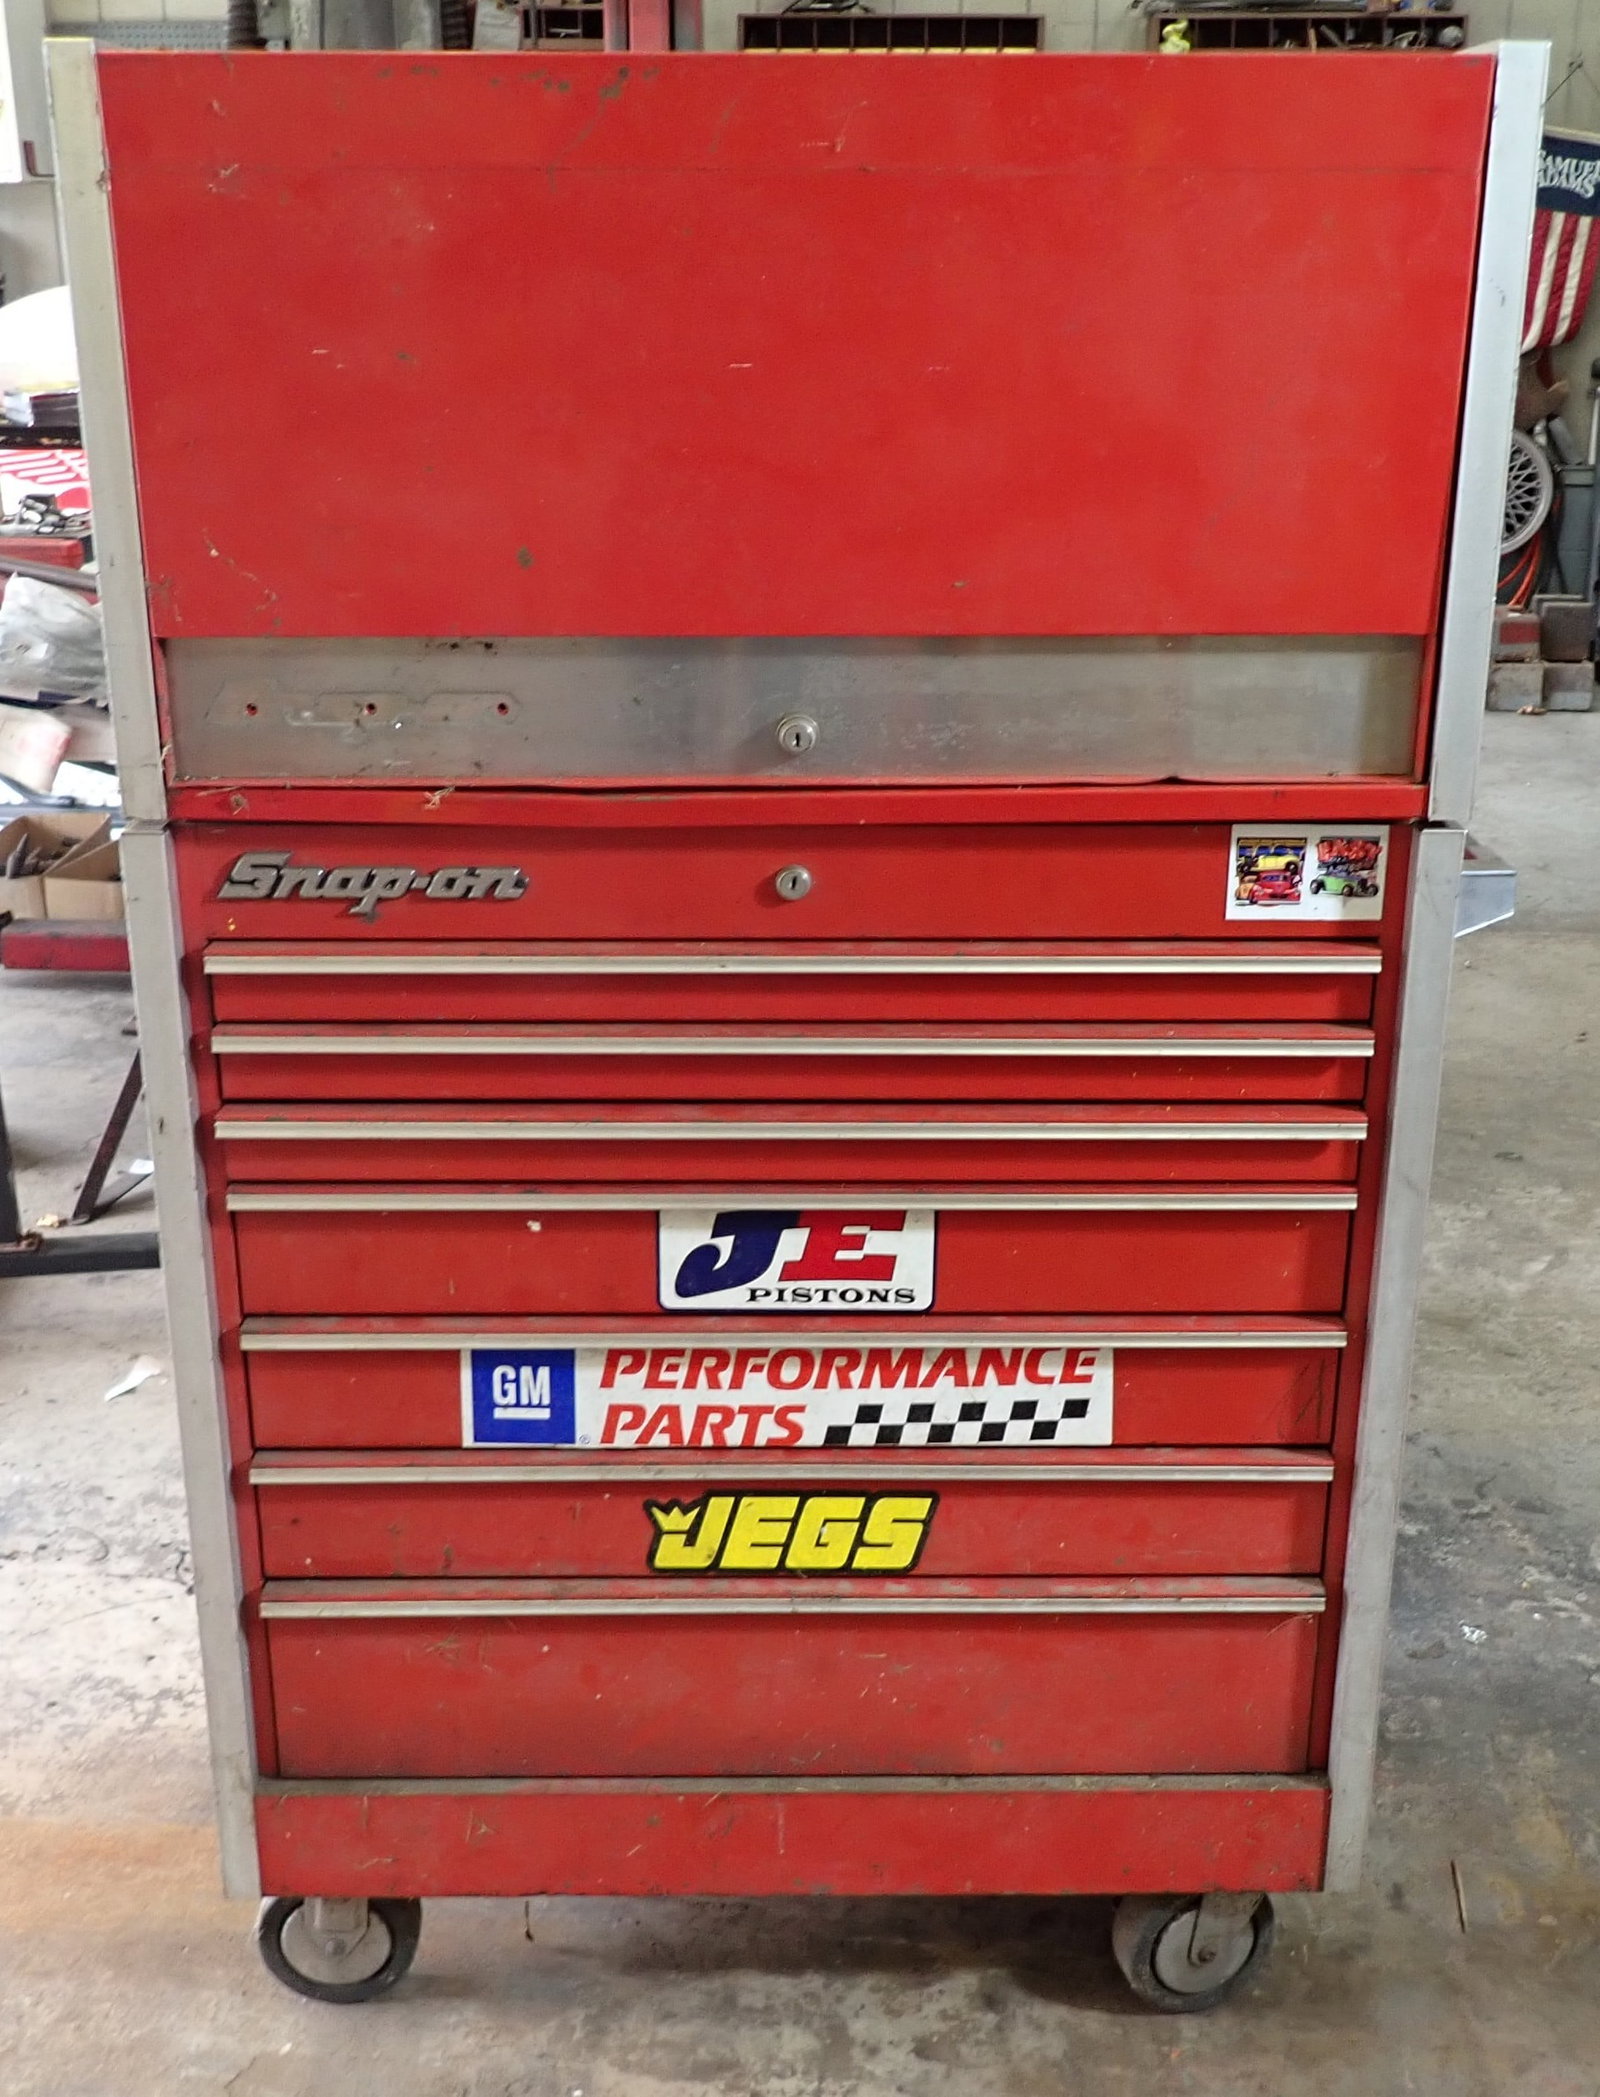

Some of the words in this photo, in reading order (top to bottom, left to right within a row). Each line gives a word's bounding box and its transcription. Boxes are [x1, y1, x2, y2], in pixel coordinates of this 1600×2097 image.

[218, 851, 530, 922] Snap-on
[675, 1210, 907, 1298] JE
[746, 1287, 917, 1304] PISTONS
[492, 1365, 550, 1406] GM
[600, 1347, 1100, 1390] PERFORMANCE
[600, 1403, 806, 1447] PARTS
[652, 1496, 933, 1569] JEGS
